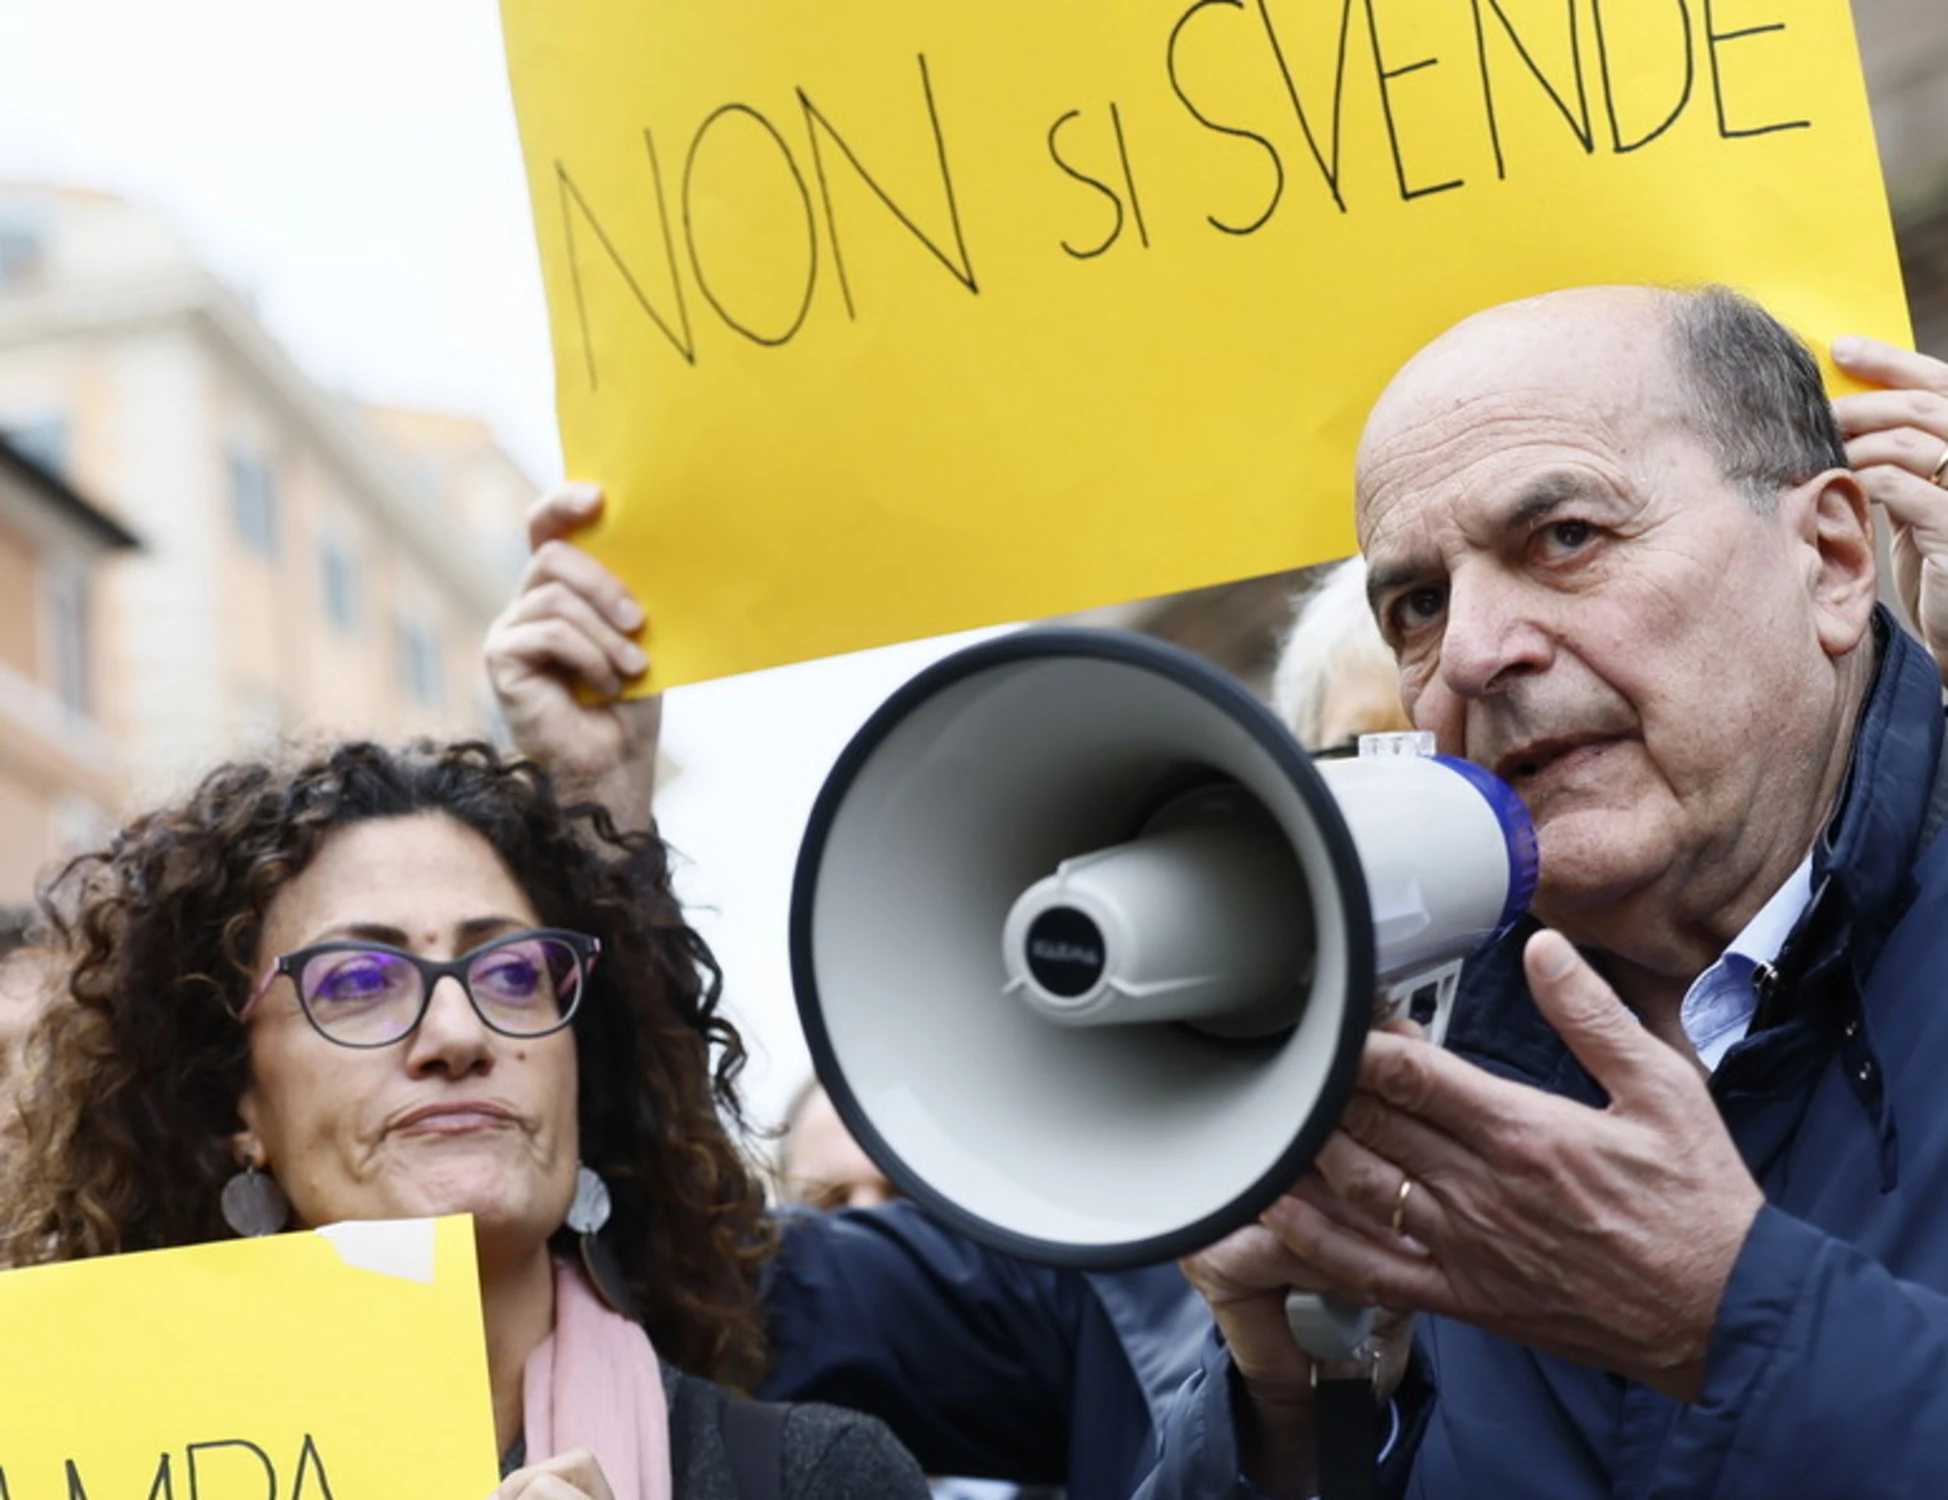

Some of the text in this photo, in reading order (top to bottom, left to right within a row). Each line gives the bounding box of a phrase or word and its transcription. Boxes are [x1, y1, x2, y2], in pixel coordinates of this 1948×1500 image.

[555, 0, 1811, 392] NON SI SVENDE
